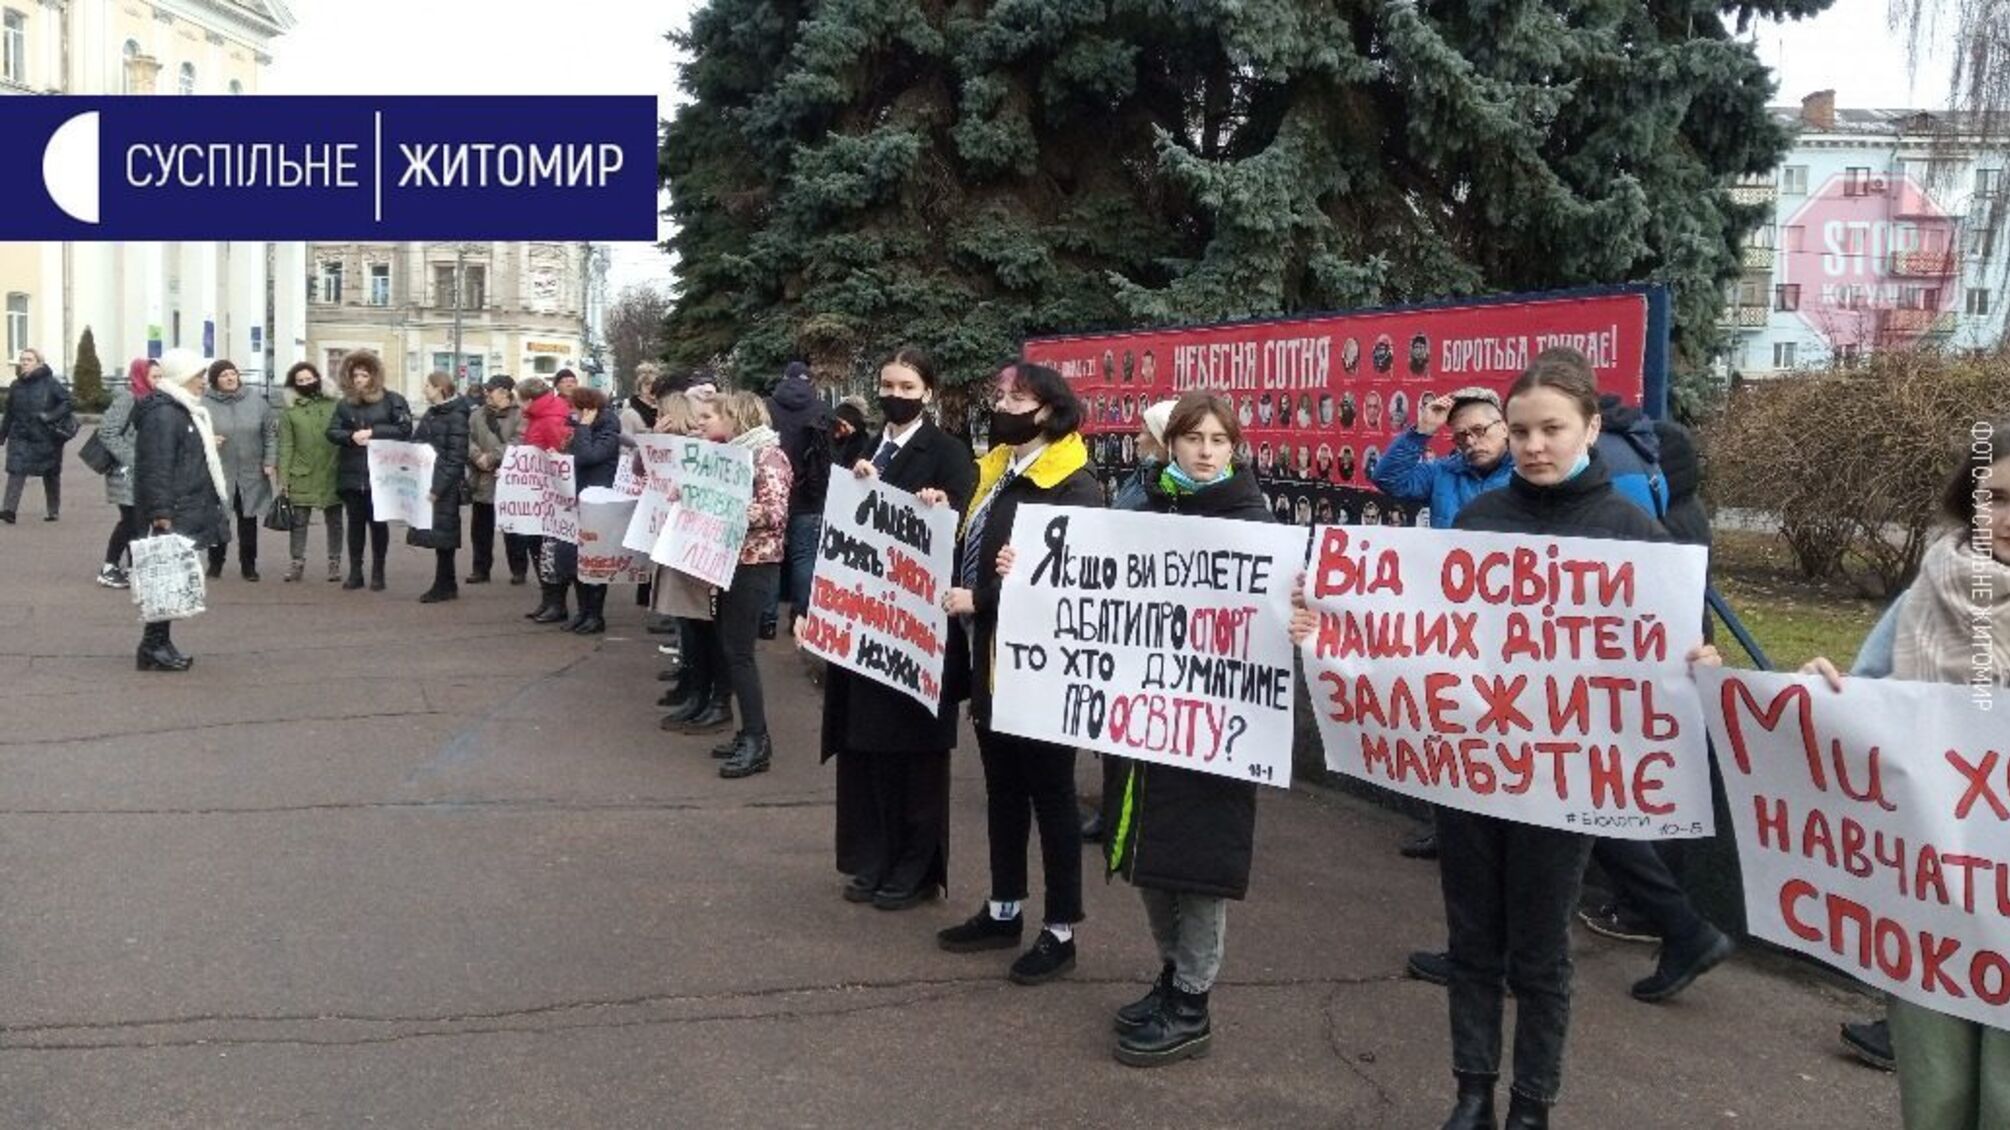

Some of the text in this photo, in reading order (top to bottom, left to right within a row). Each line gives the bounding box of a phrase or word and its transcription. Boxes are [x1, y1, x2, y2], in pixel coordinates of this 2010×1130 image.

[1263, 336, 1332, 390] СОТНЯ
[1441, 335, 1529, 373] БОРОТЬБА
[1030, 515, 1274, 594] Якщо ВИ БУДЕТЕ
[1054, 597, 1258, 661] ДБАТИ ПРО СПОРТ
[1316, 609, 1480, 661] НАШИХ
[1005, 641, 1291, 711] ТО ХТО ДУМАТИМЕ
[1318, 670, 1680, 742] ЗАЛЕЖИТЬ
[1062, 684, 1248, 762] ПРО ОСВІТУ?
[1720, 677, 1898, 812] Ми
[1361, 732, 1677, 816] МАЙБУТНЄ
